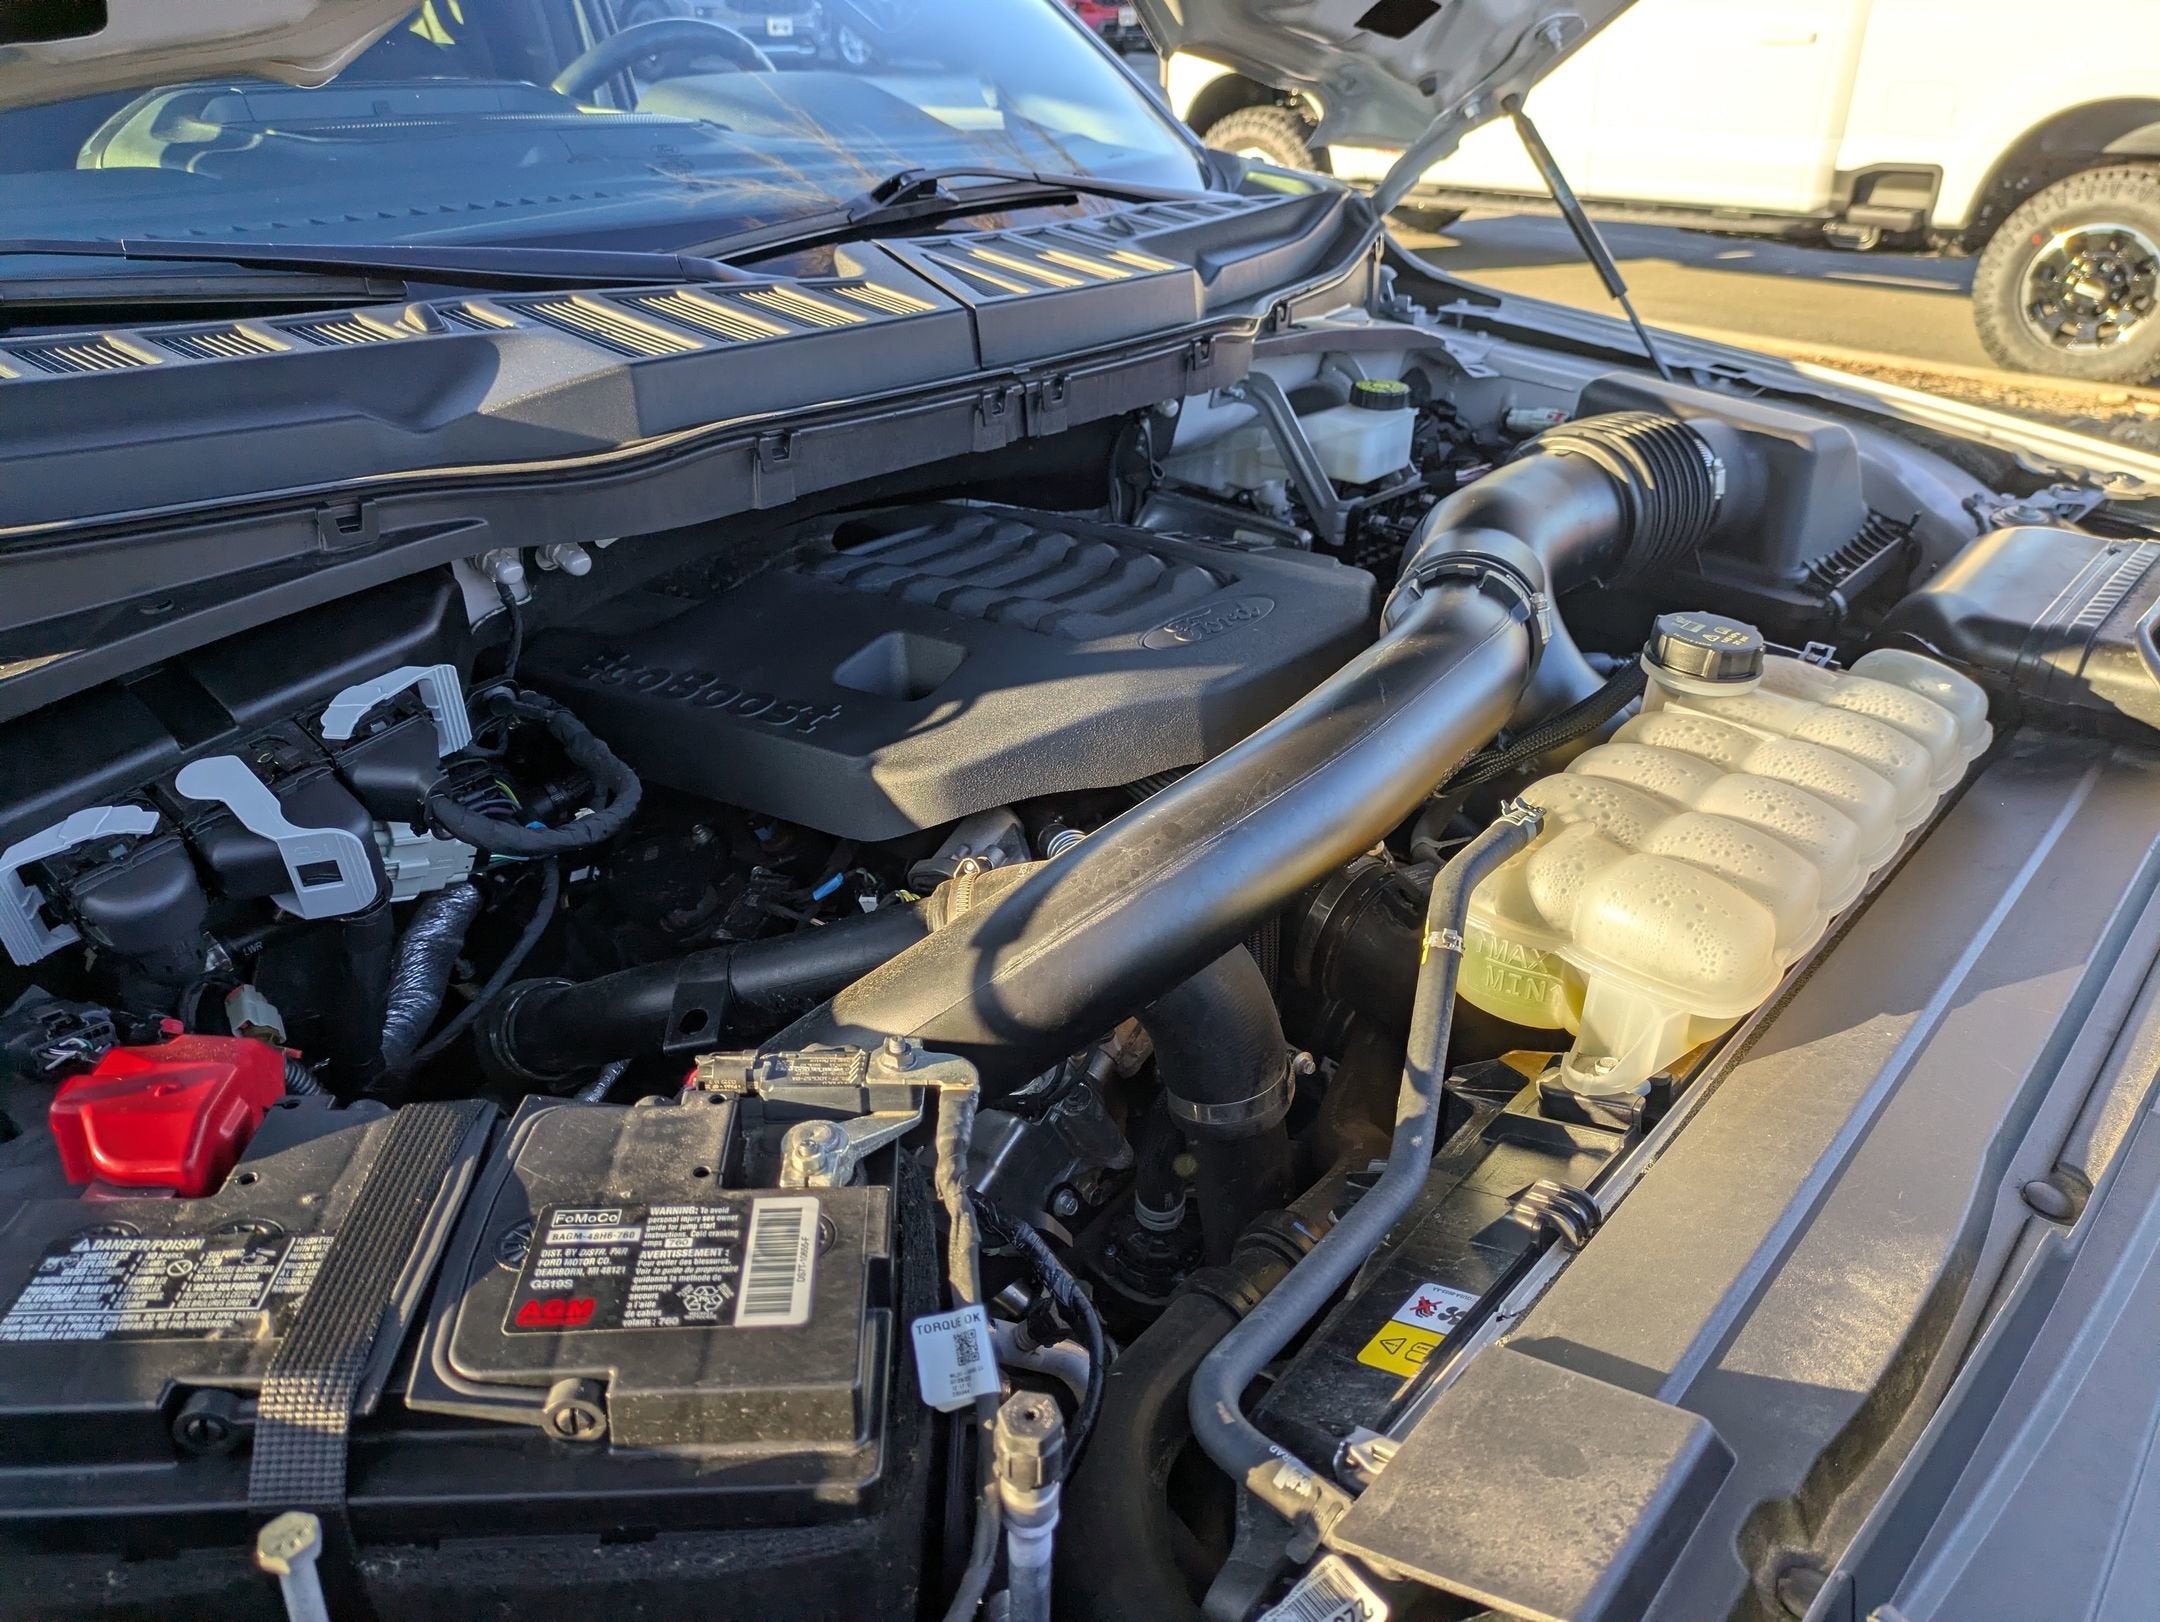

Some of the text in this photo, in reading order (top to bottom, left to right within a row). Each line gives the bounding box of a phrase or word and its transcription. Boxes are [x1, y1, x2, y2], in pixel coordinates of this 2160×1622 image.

[1163, 602, 1261, 642] Ford
[1491, 935, 1548, 973] MAX
[1487, 965, 1546, 1002] MIN
[650, 1207, 698, 1216] WARNING:
[709, 1206, 730, 1214] avoid
[555, 1212, 618, 1224] FoMoCo
[648, 1216, 680, 1225] personal
[680, 1215, 702, 1225] injury
[716, 1214, 739, 1222] owner
[646, 1224, 670, 1233] guide
[679, 1223, 698, 1232] jump
[698, 1222, 716, 1230] start
[690, 1230, 707, 1238] Cold
[707, 1229, 739, 1239] cranking
[91, 1239, 206, 1251] DANGER/POISON
[297, 1237, 319, 1245] FLUSH
[642, 1238, 689, 1249] amps 760
[81, 1252, 131, 1260] SHIELD EYES
[541, 1247, 629, 1258] DIST. BY DISTR. PAR
[639, 1248, 724, 1260] AVERTISSEMENT
[537, 1257, 612, 1267] FORD MOTOR CO.
[637, 1260, 655, 1268] Pour
[678, 1258, 692, 1266] des
[213, 1266, 236, 1274] CAUSE
[235, 1265, 275, 1273] BLINDNESS
[534, 1265, 627, 1277] DEARBORN, MI 48121
[635, 1268, 652, 1276] Voir
[661, 1267, 684, 1277] guide
[684, 1266, 695, 1274] du
[192, 1273, 259, 1282] OR SEVERE BURNS
[678, 1274, 711, 1282] methode
[630, 1284, 673, 1293] demarrage
[628, 1292, 660, 1301] secours
[214, 1312, 236, 1320] OPEN
[516, 1298, 597, 1325] AGM
[624, 1309, 663, 1318] de cables
[658, 1316, 681, 1327] 760
[915, 1312, 982, 1335] TORQUE OK
[1333, 1597, 1374, 1622] 22
